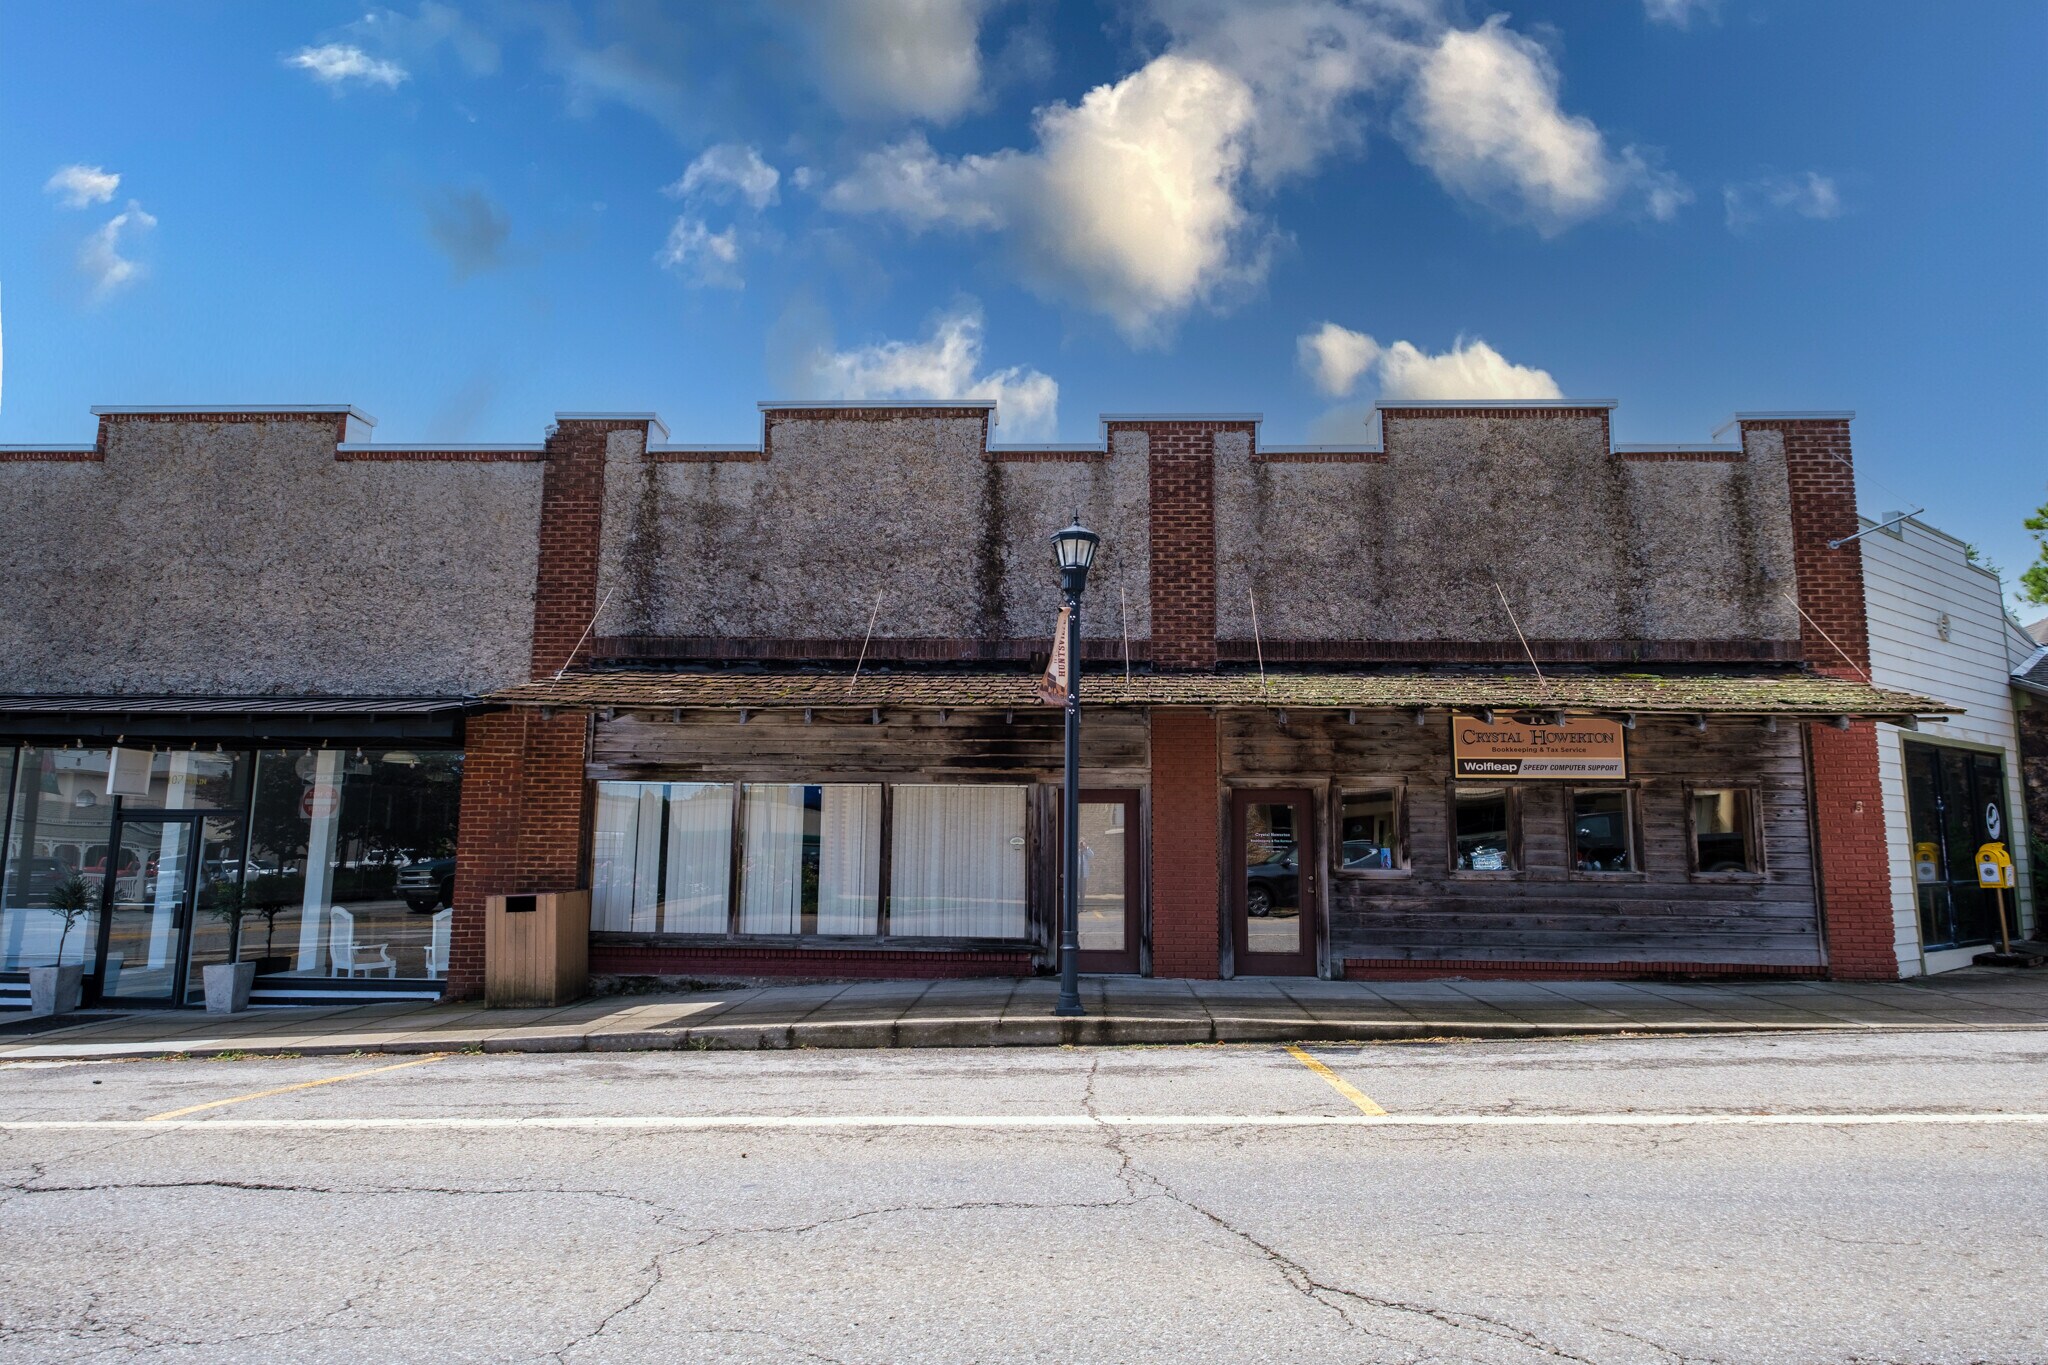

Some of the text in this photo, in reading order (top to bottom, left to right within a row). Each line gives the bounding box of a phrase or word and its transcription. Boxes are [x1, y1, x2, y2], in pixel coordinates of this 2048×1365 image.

[1461, 729, 1615, 745] CRYSTAL HOWERTON
[1464, 762, 1518, 773] Wolfleap
